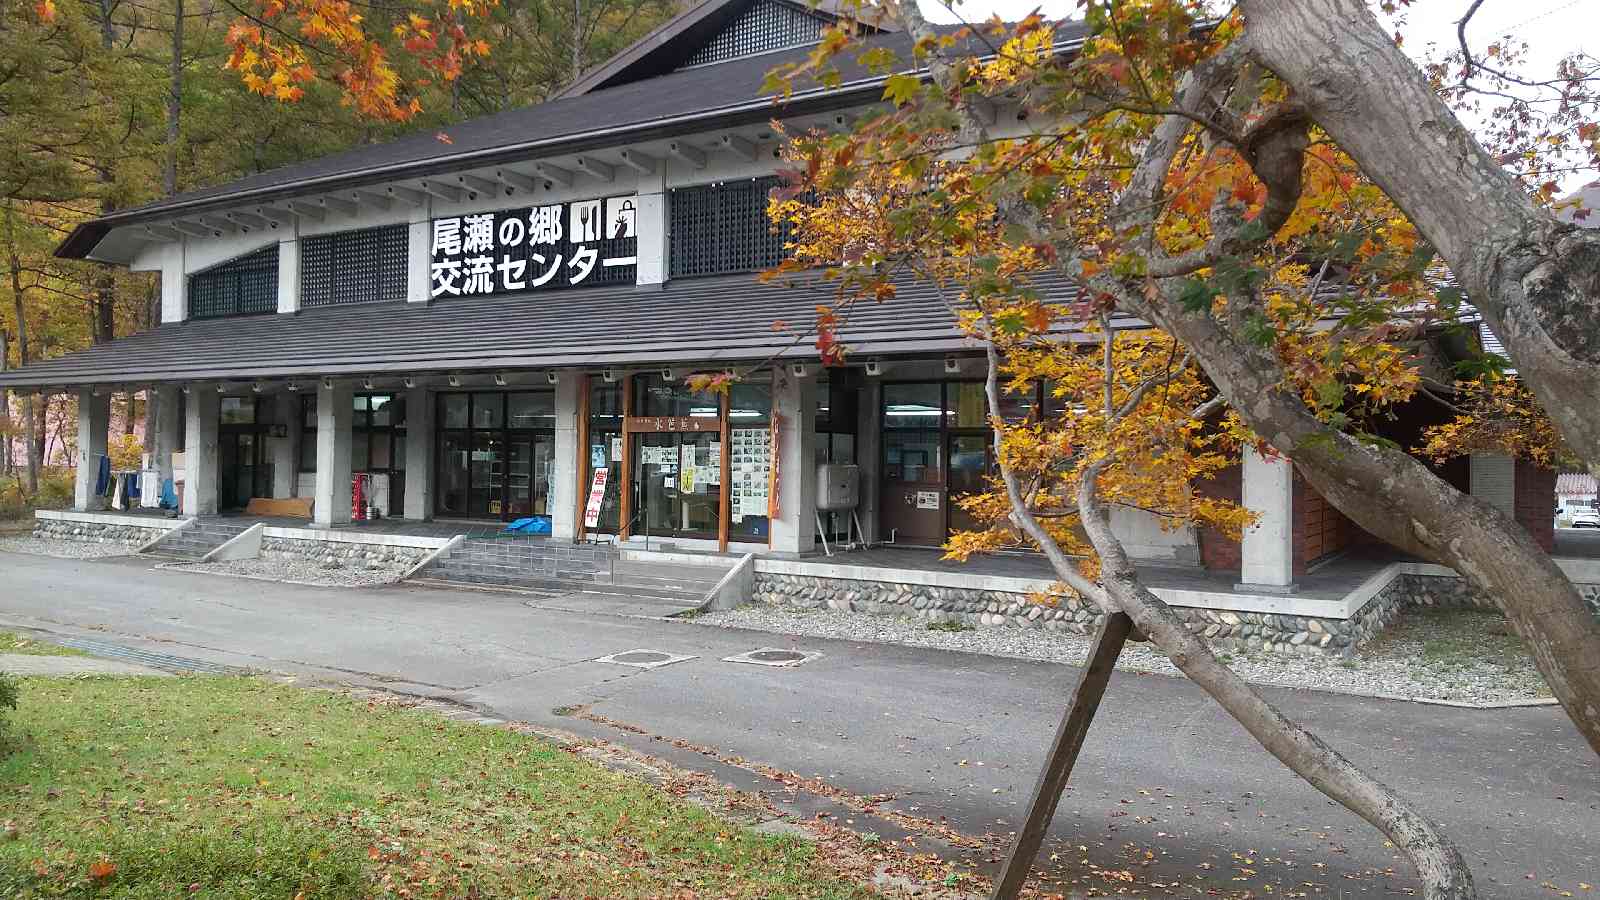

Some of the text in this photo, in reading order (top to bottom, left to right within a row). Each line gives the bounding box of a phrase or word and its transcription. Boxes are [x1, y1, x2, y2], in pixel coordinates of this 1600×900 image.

[431, 204, 563, 257] 尾瀬の郷
[431, 245, 637, 297] 交流センター
